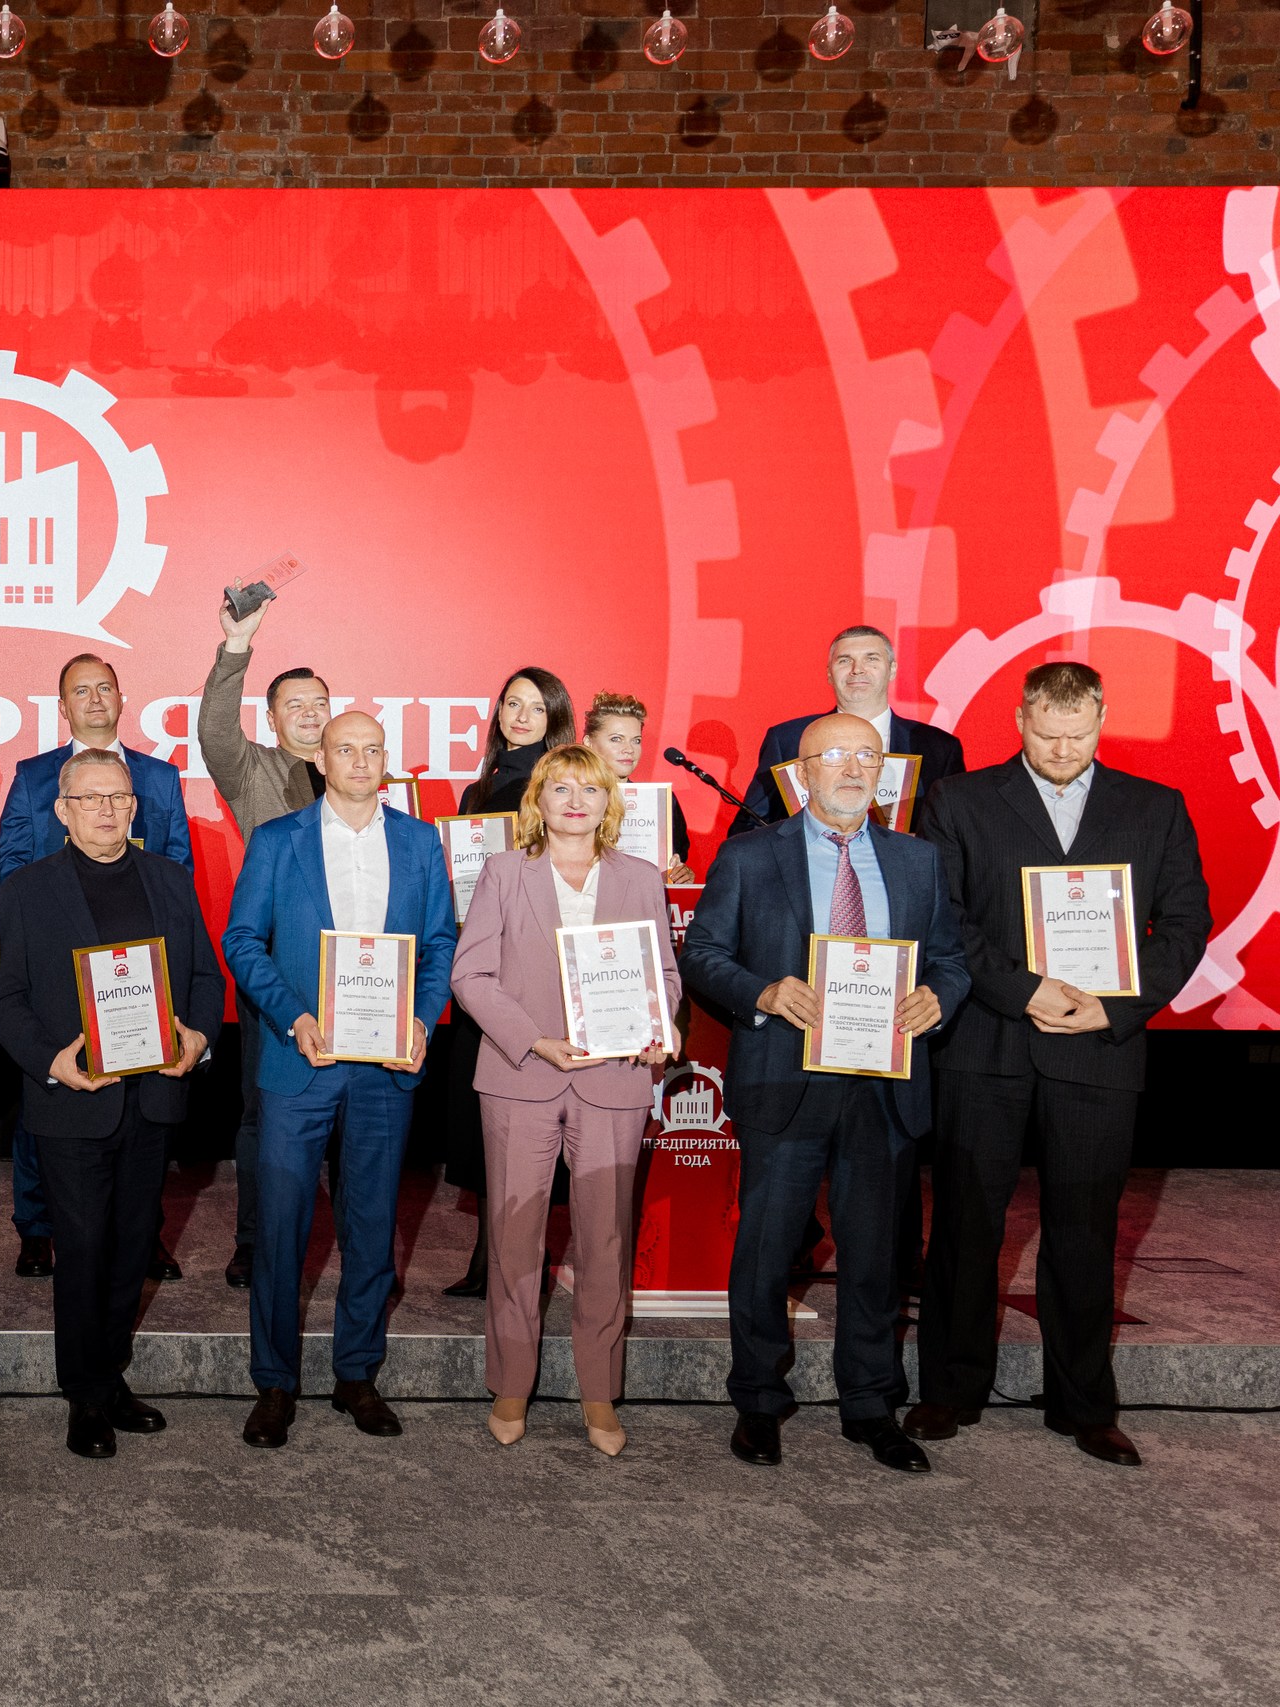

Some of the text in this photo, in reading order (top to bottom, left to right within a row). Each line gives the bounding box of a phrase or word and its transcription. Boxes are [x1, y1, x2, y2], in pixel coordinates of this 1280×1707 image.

[453, 851, 494, 864] ДИПЛО
[1046, 910, 1112, 923] ДИПЛОМ
[337, 975, 395, 988] ДИПЛОМ
[581, 968, 642, 985] ДИПЛОМ
[97, 984, 152, 1003] ДИПЛОМ
[827, 981, 892, 997] ДИПЛОМ
[674, 1154, 712, 1168] ГОДА
